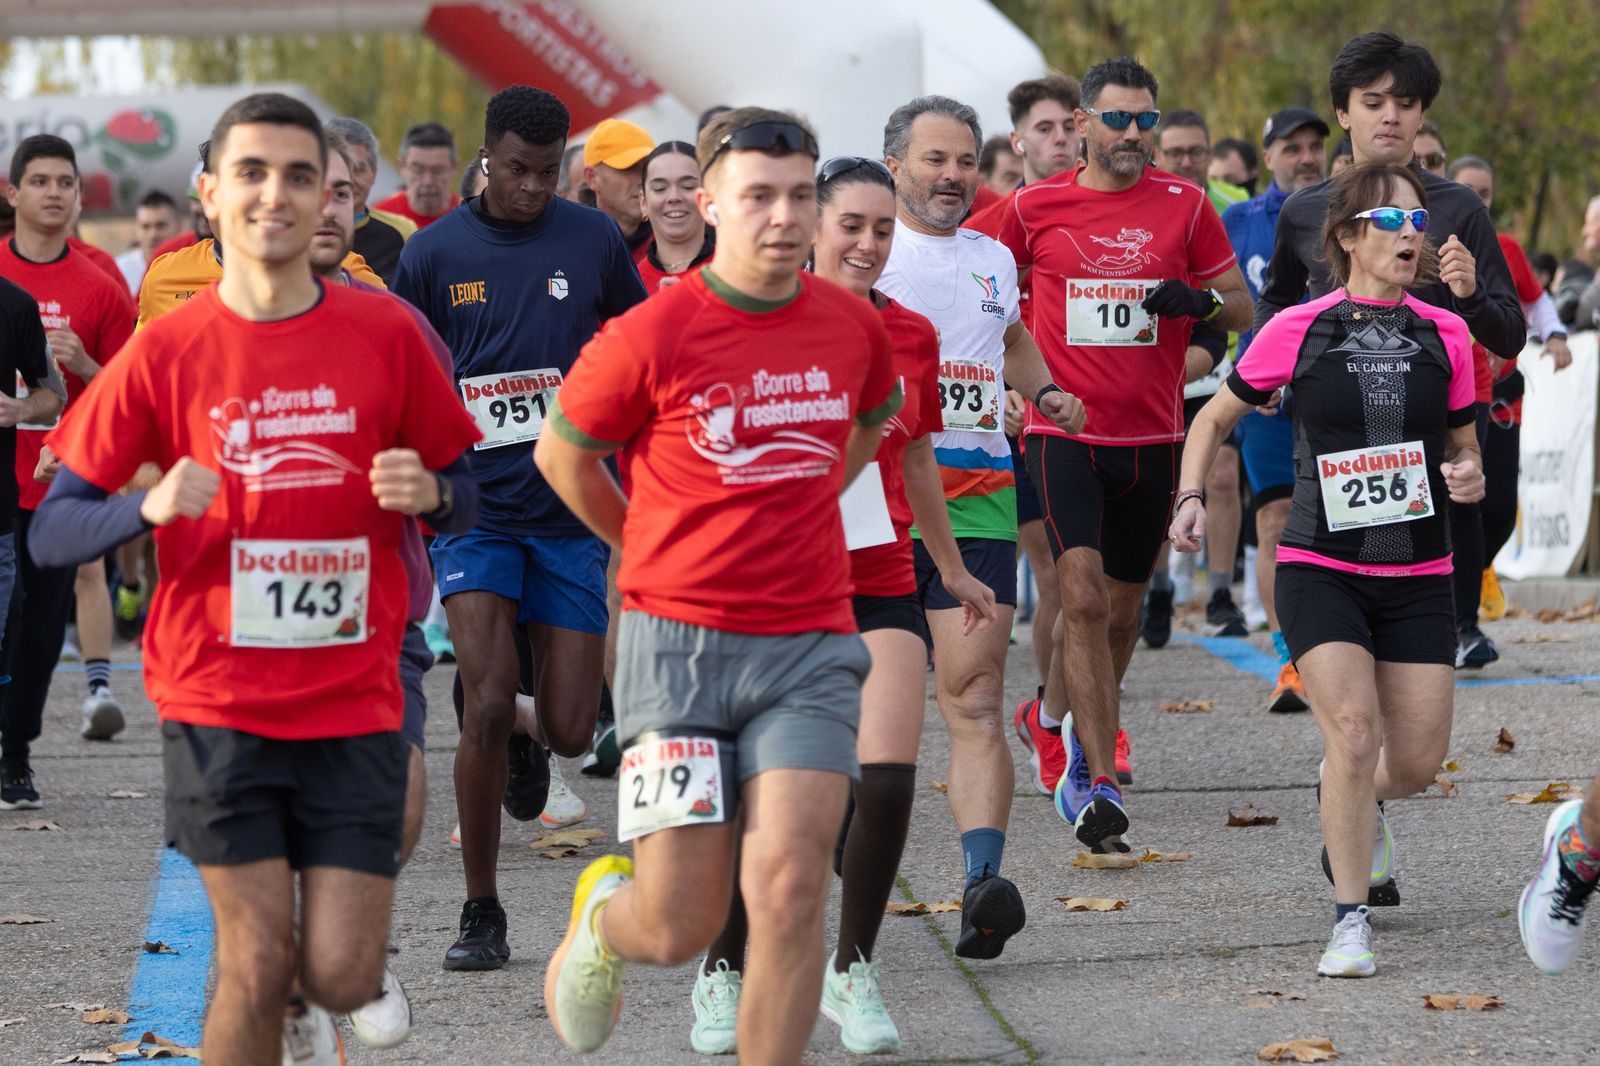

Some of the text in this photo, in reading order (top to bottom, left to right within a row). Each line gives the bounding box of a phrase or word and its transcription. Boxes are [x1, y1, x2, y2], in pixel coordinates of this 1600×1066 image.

[449, 281, 487, 307] LEONE
[981, 304, 1005, 316] CORRE
[1097, 303, 1131, 329] 10
[804, 365, 830, 392] sin
[1346, 360, 1411, 373] EL CAINEJÍN
[311, 383, 337, 408] sin
[464, 373, 562, 402] bedunia
[488, 393, 547, 429] 951
[743, 391, 849, 428] resistencias!
[1321, 449, 1423, 479] bedunia
[1343, 472, 1408, 509] 256
[237, 548, 365, 574] bedunia
[266, 580, 343, 619] 143
